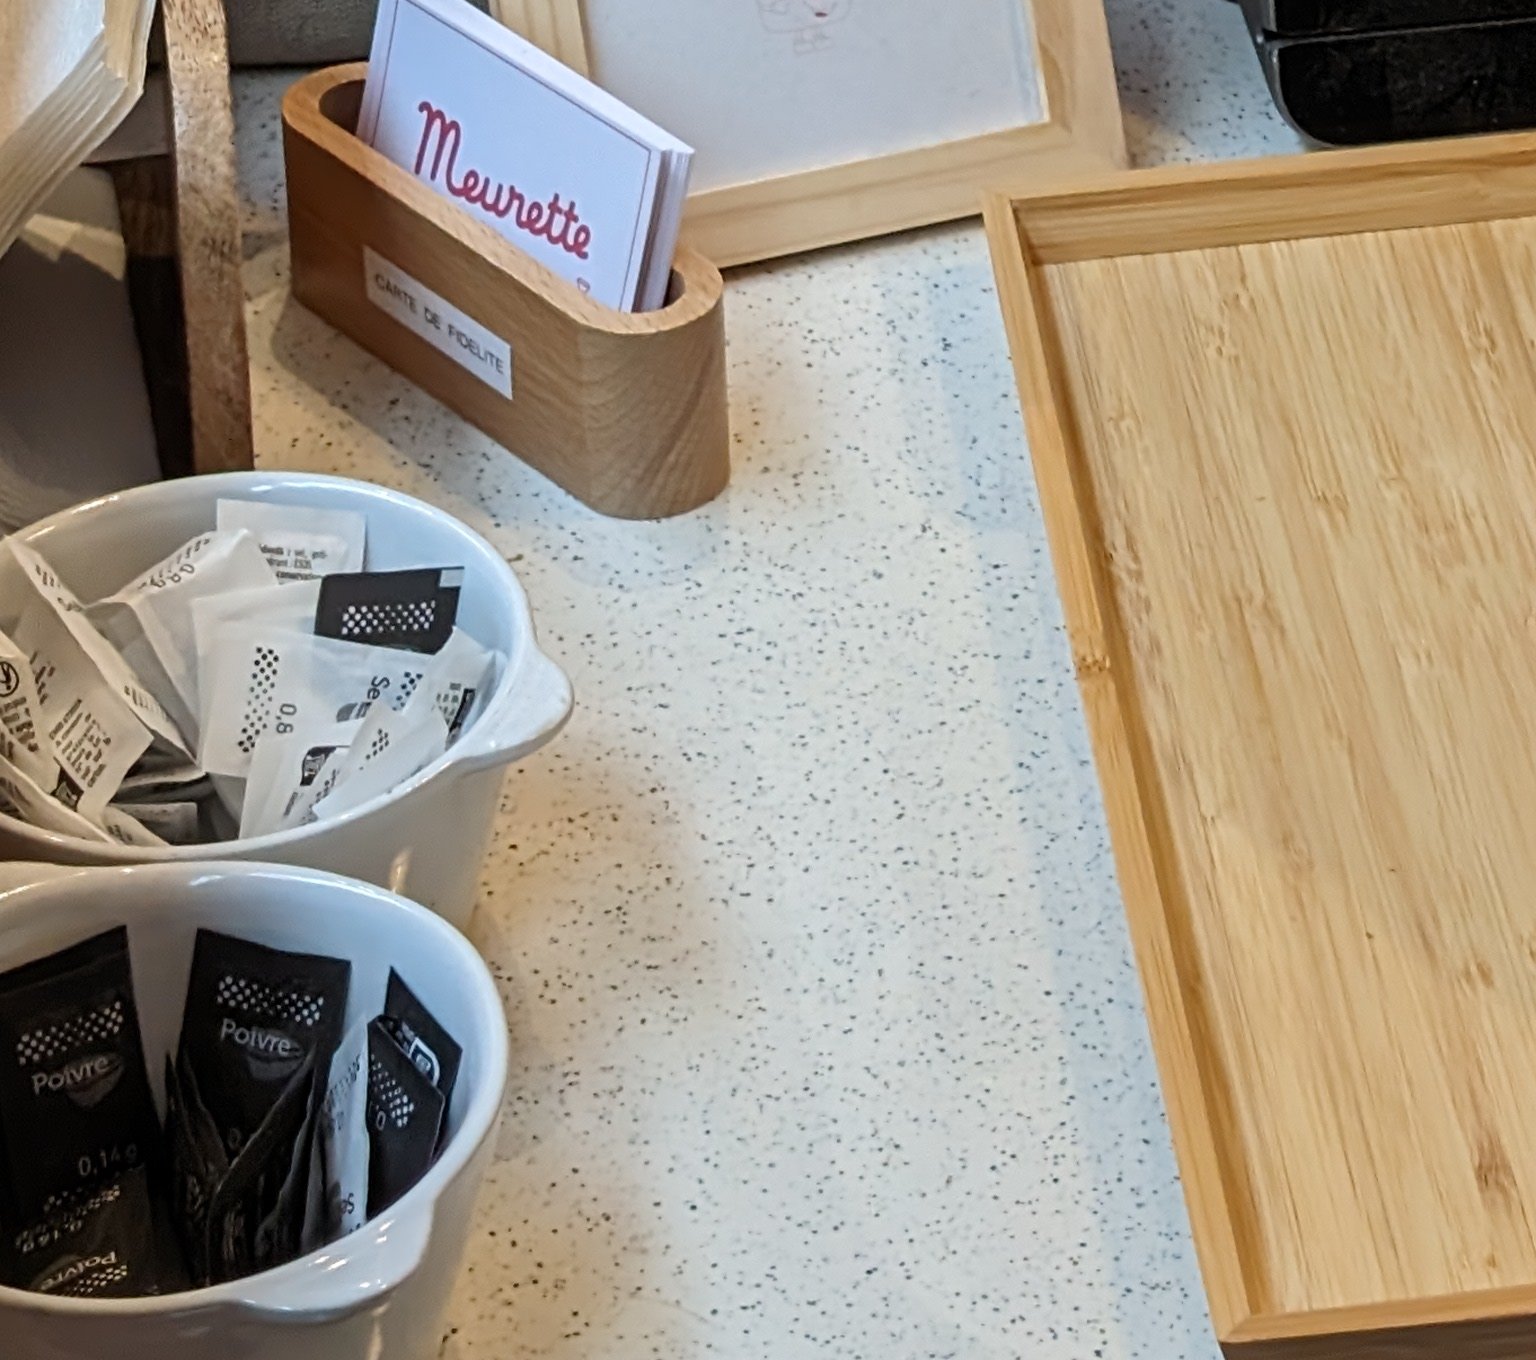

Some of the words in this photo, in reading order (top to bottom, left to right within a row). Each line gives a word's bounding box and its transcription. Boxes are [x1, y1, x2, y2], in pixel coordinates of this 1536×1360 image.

[412, 100, 592, 261] Meurette
[375, 273, 418, 314] CARTE
[424, 306, 441, 330] DE
[220, 1018, 292, 1057] Poivre
[31, 1056, 109, 1096] Poivre
